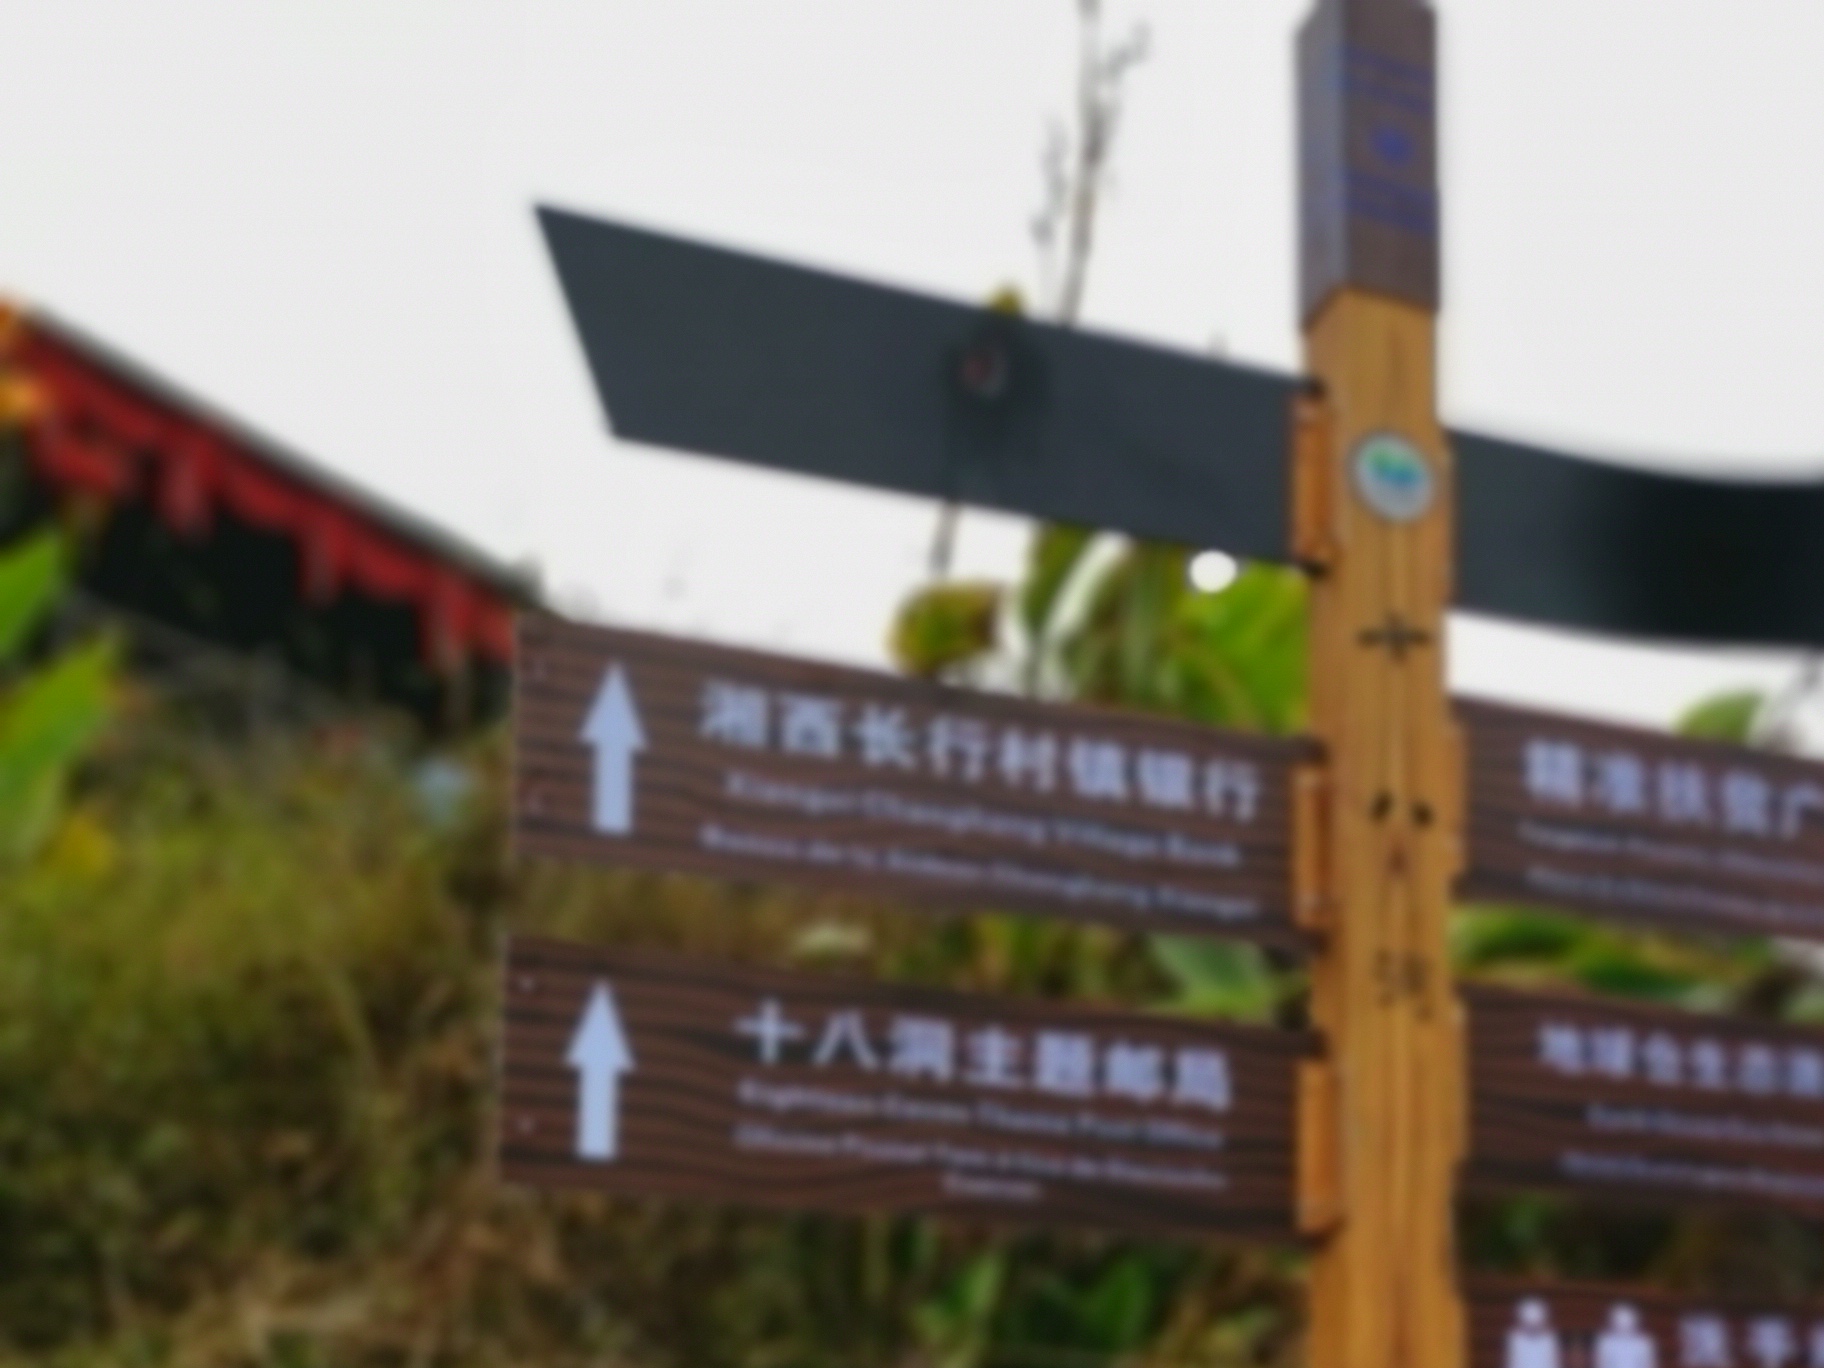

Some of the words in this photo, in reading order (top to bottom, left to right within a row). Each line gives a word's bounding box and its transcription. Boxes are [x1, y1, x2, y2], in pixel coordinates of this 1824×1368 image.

[735, 1002, 1231, 1111] 十八洞主题邮局
